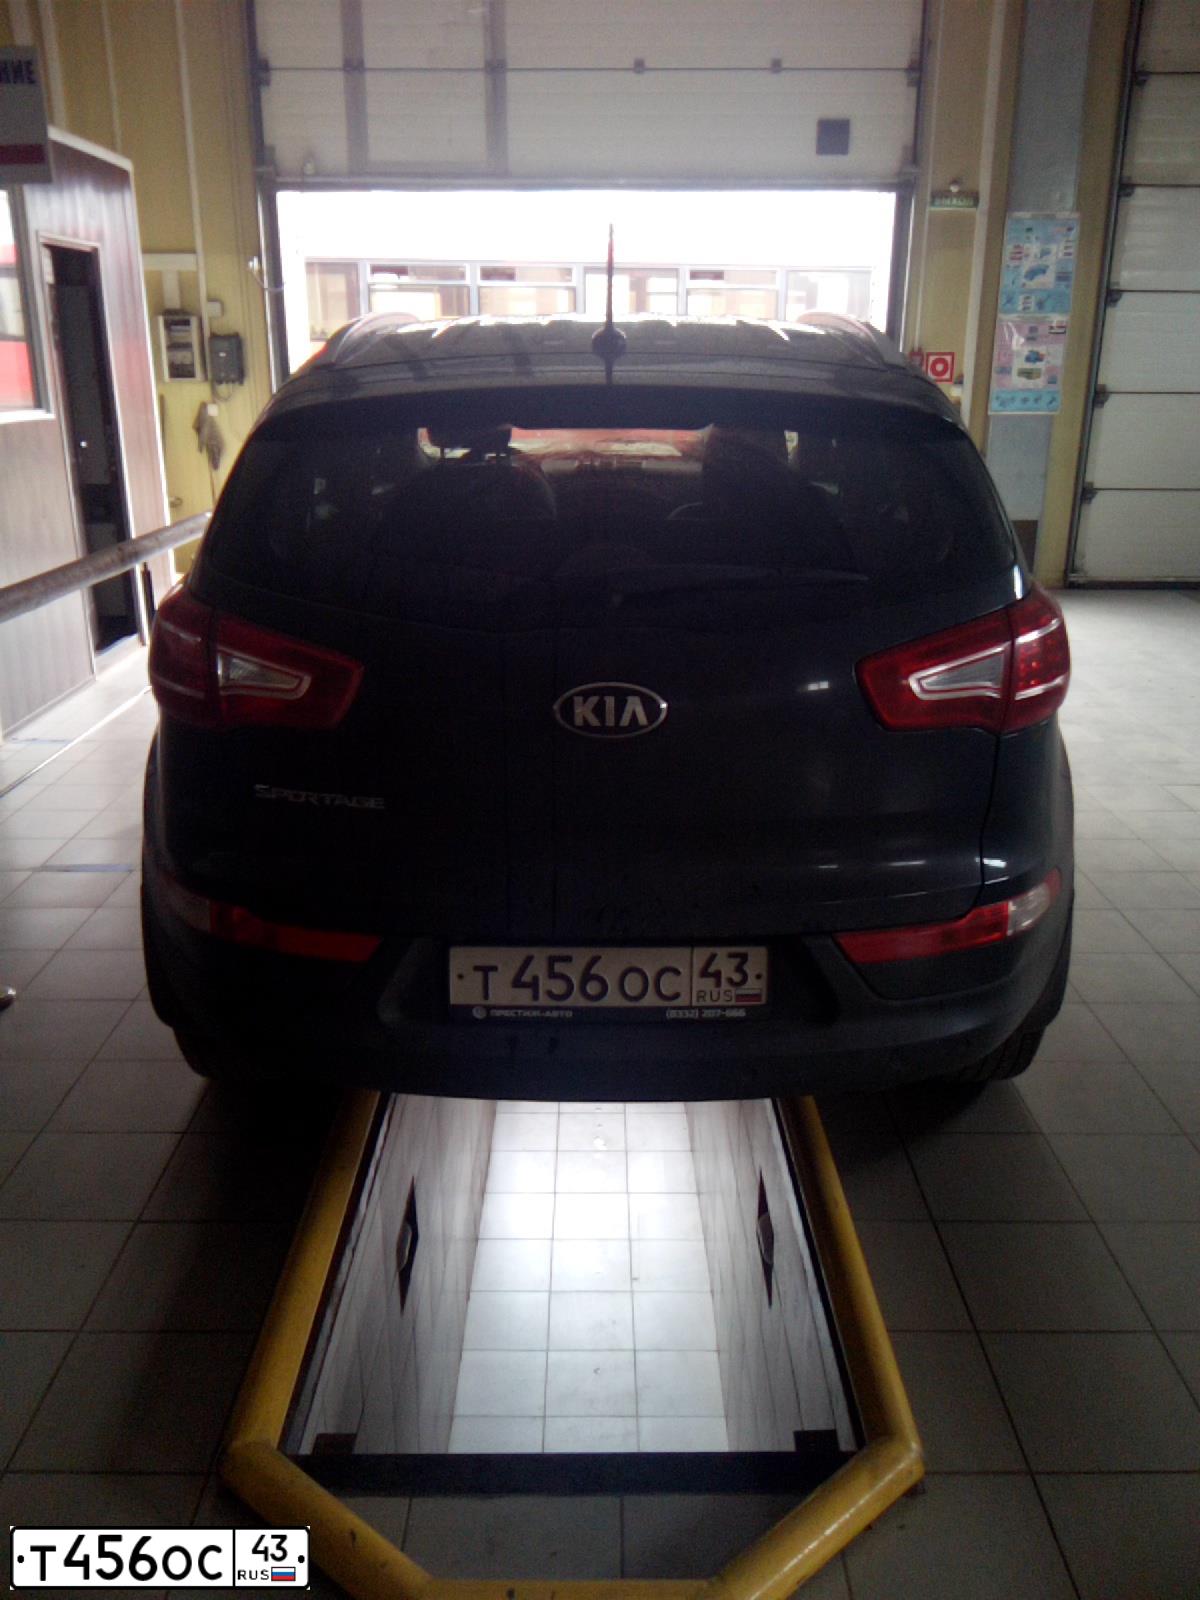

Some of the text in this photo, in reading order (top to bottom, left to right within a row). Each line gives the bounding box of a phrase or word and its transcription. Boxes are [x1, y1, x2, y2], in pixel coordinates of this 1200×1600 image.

[572, 695, 649, 727] KIA
[699, 951, 749, 989] 43
[695, 989, 734, 1003] RUS
